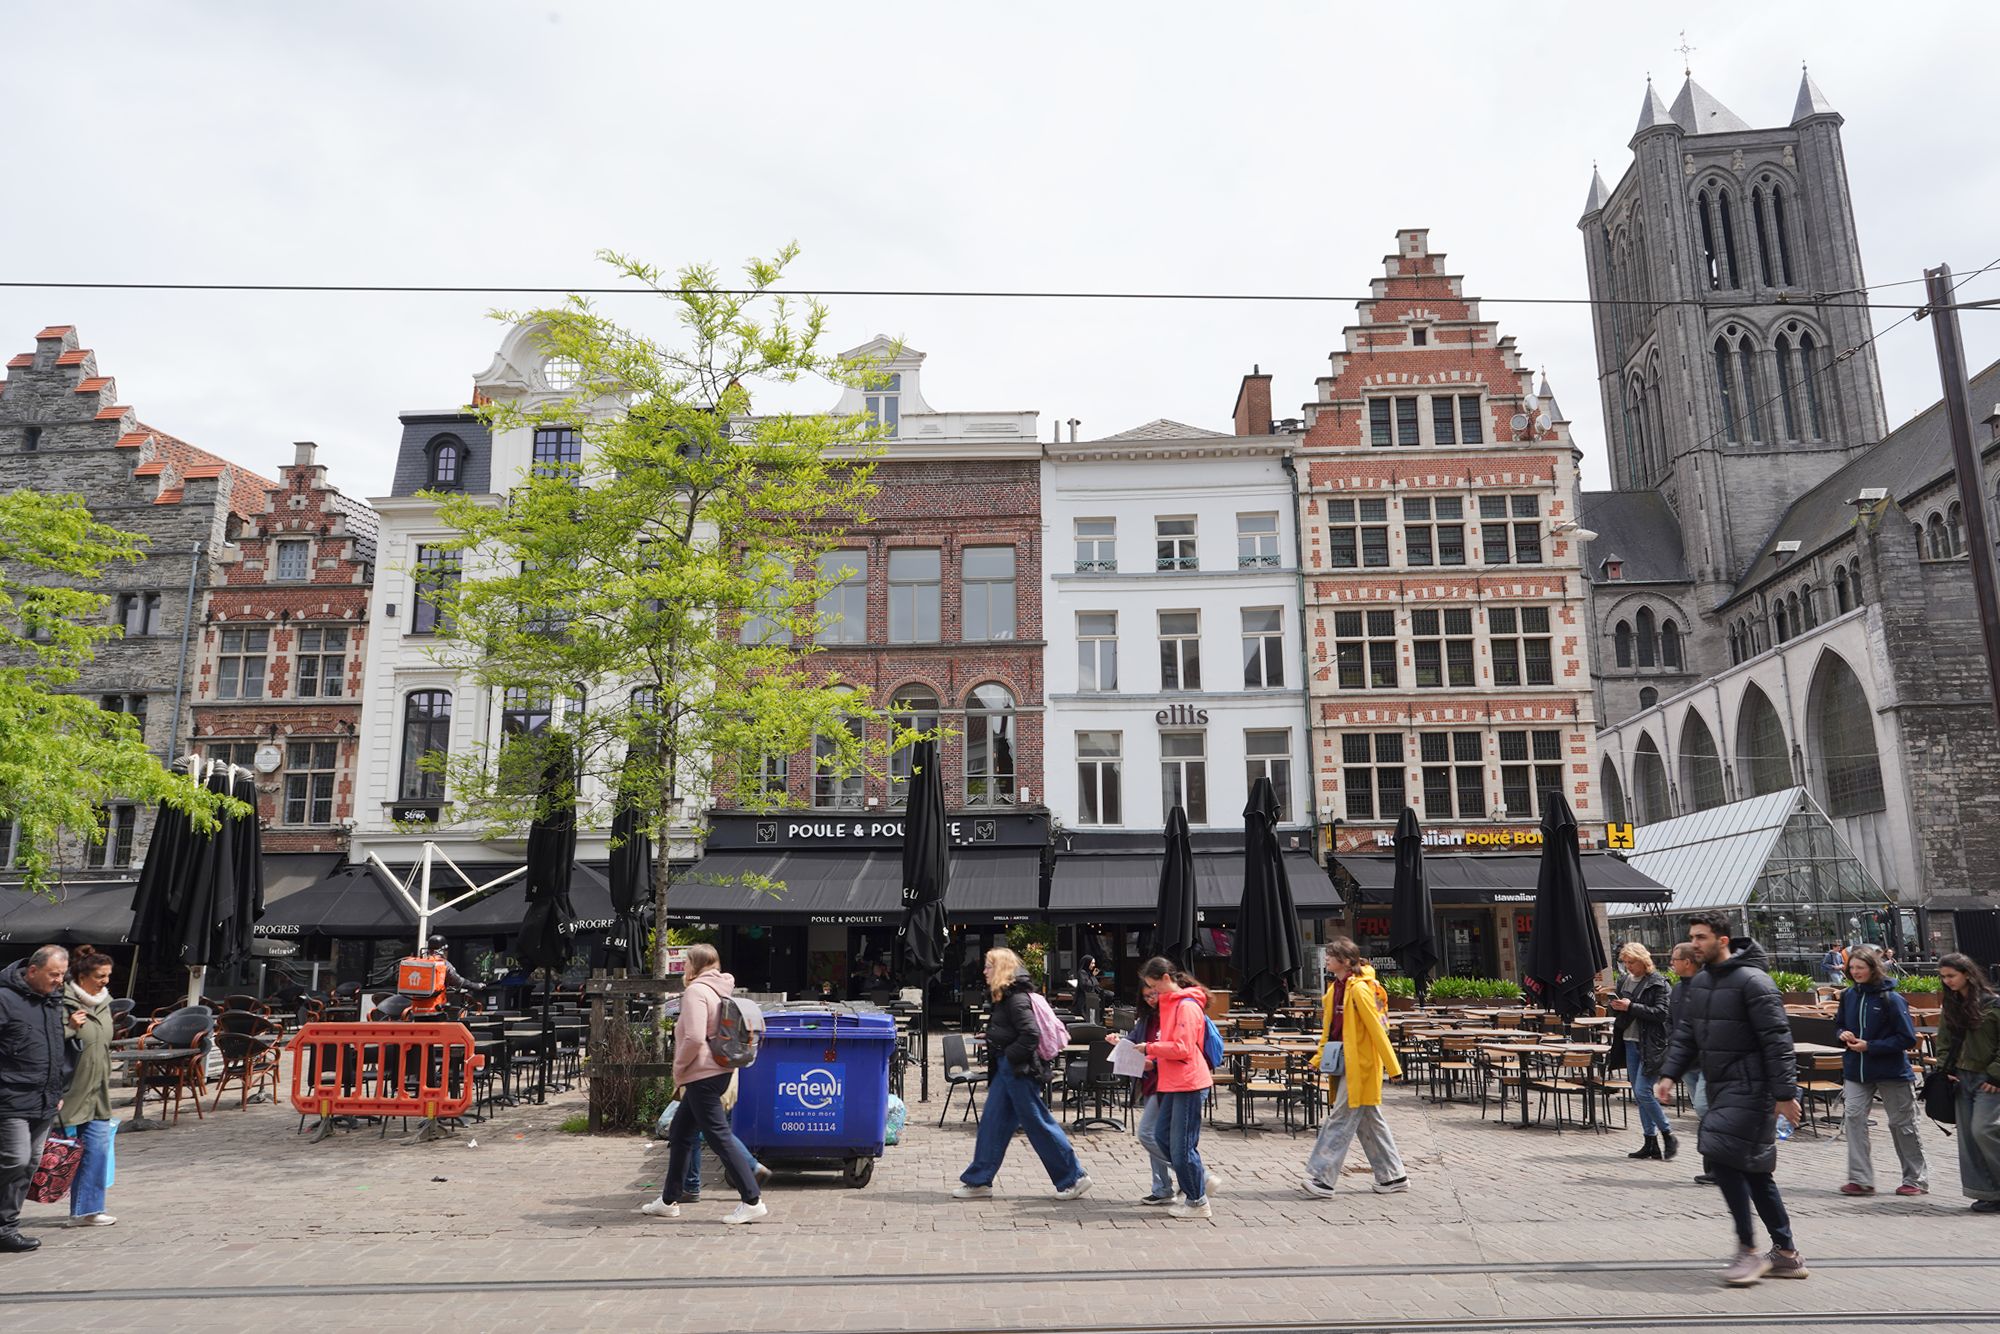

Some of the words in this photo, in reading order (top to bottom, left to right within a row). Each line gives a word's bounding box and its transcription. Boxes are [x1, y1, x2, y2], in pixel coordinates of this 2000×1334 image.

[1155, 704, 1209, 725] ellis
[788, 823, 846, 838] POULE
[853, 824, 864, 837] &
[1377, 830, 1462, 847] Haiian
[1465, 829, 1511, 845] Poké
[1494, 893, 1537, 902] Hawaiian
[576, 919, 615, 930] ROGRE
[778, 1077, 842, 1099] renewi
[781, 1121, 805, 1131] 0800
[807, 1122, 836, 1132] 11114
